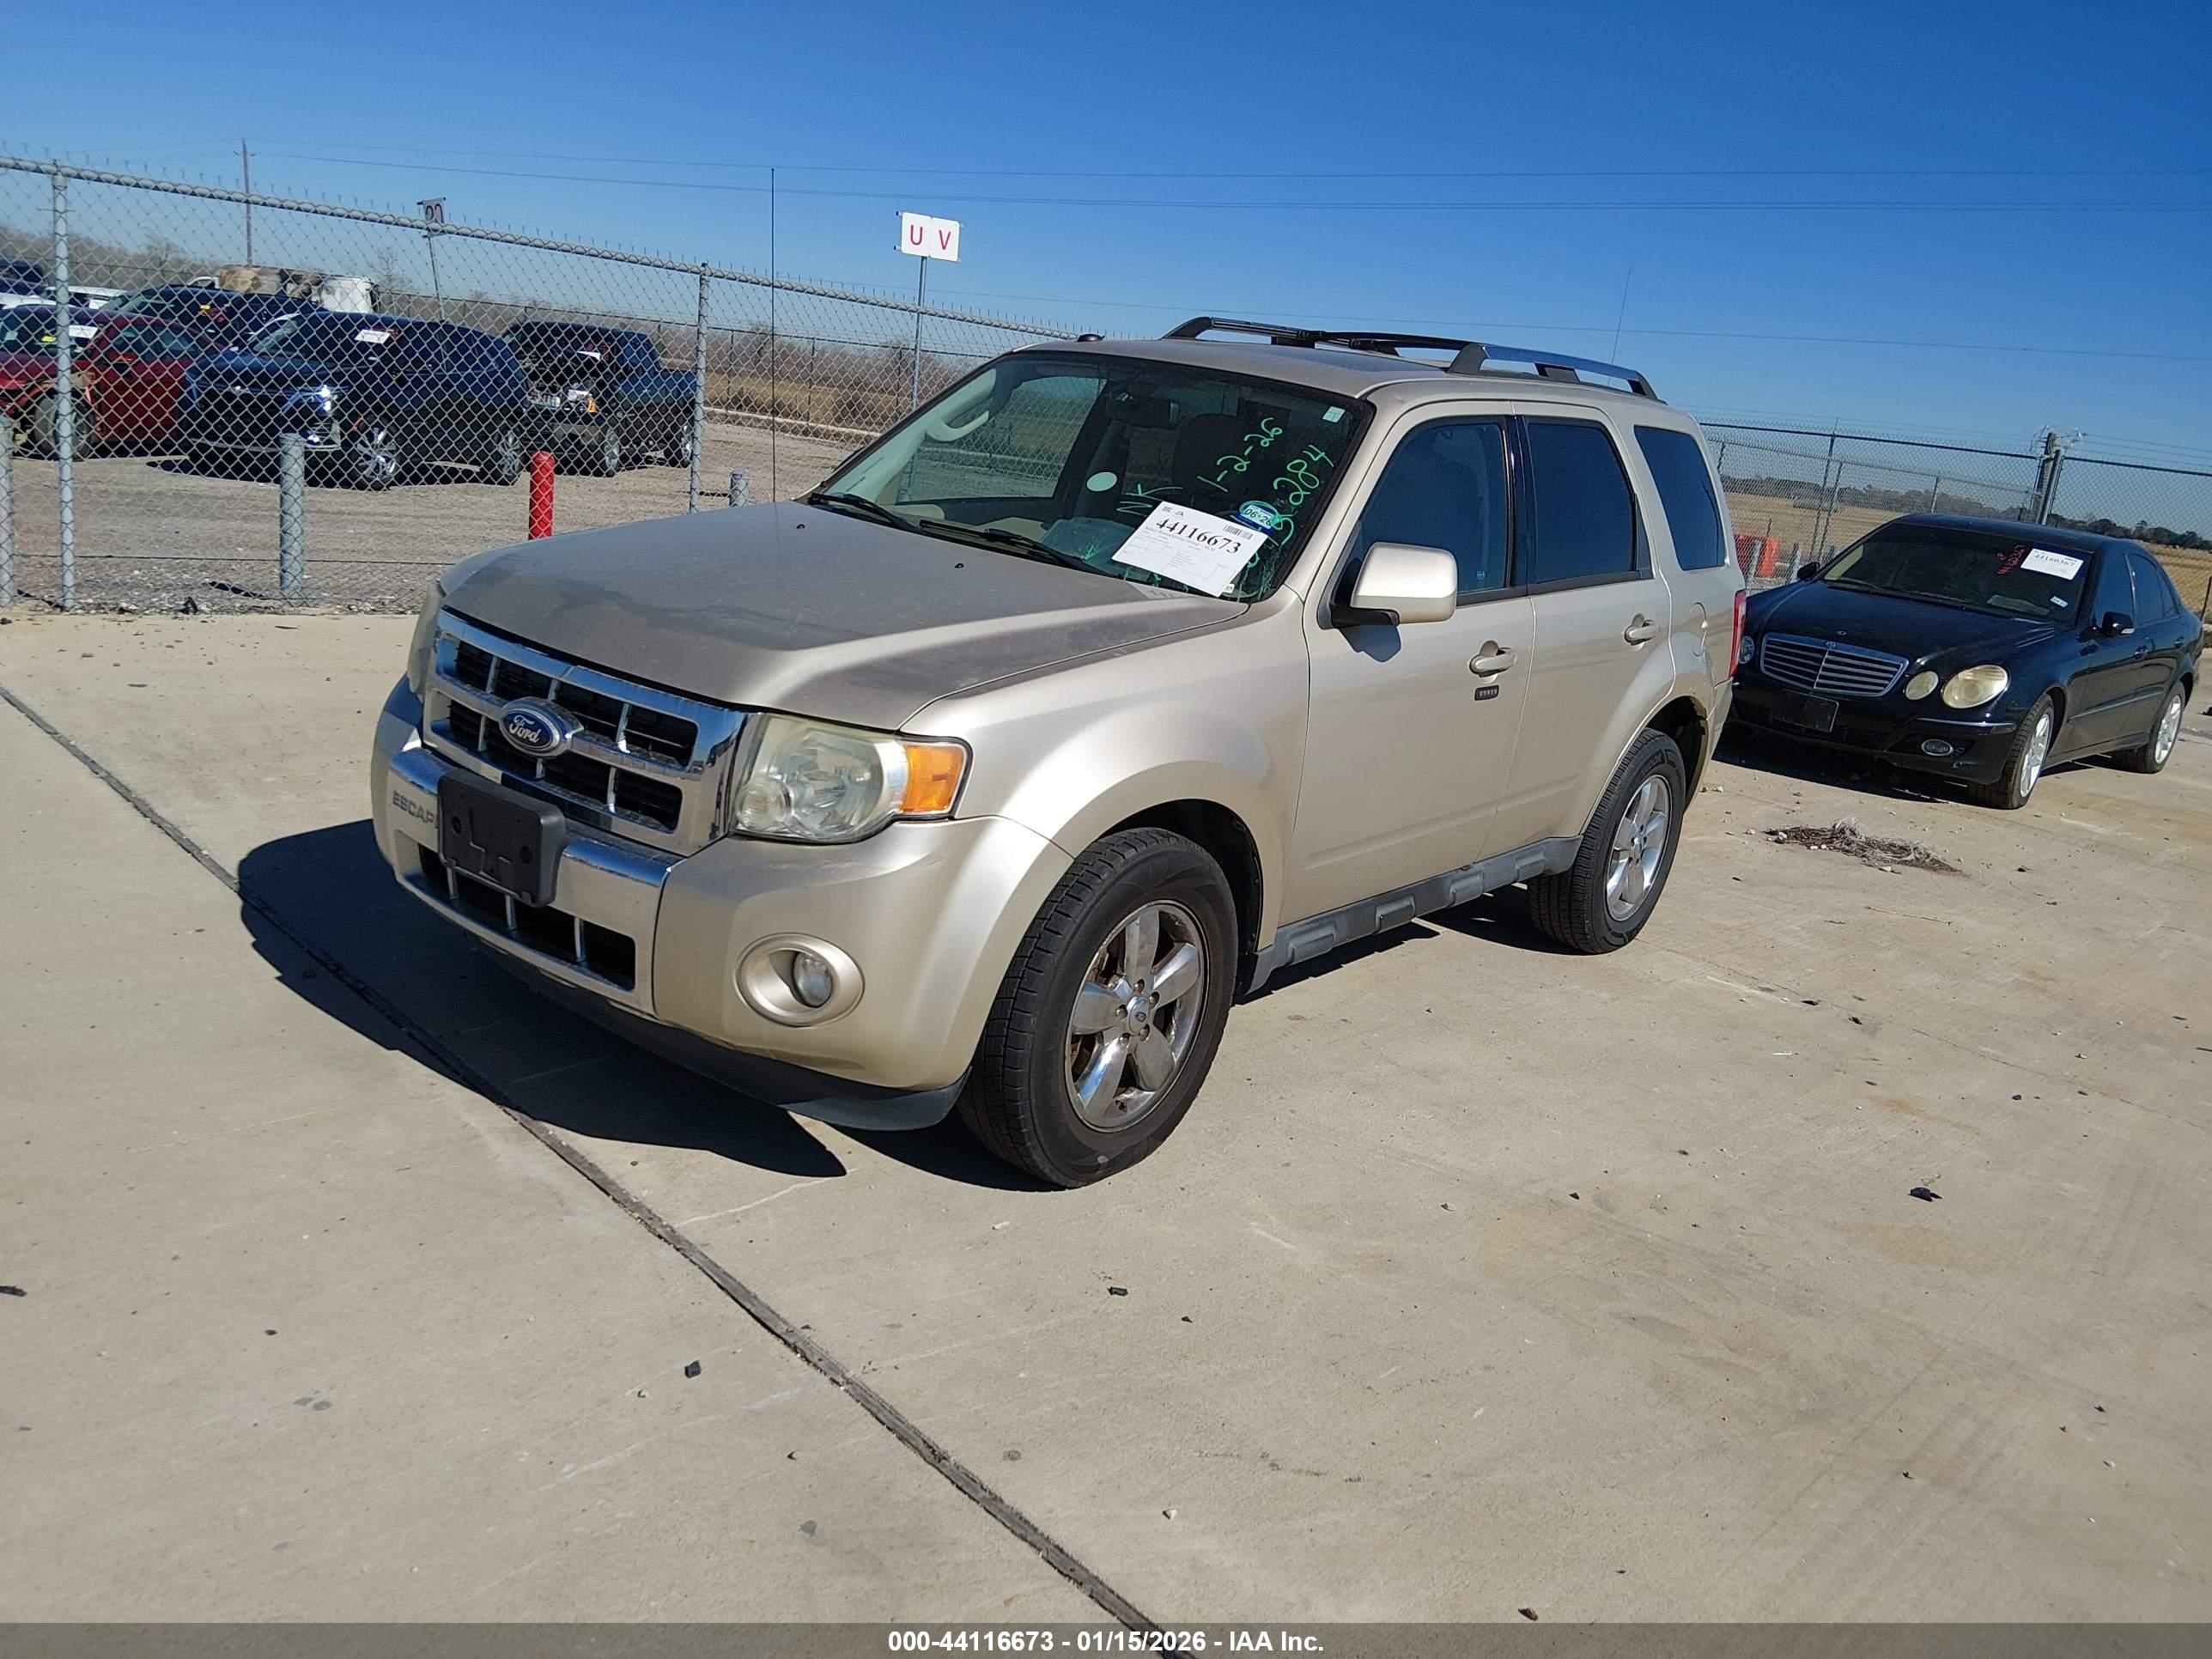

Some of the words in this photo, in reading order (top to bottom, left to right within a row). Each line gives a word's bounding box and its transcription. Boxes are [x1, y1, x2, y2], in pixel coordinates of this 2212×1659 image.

[910, 224, 923, 246] U
[939, 229, 951, 250] V
[1156, 518, 1242, 554] 44116673
[509, 714, 542, 744] Ford
